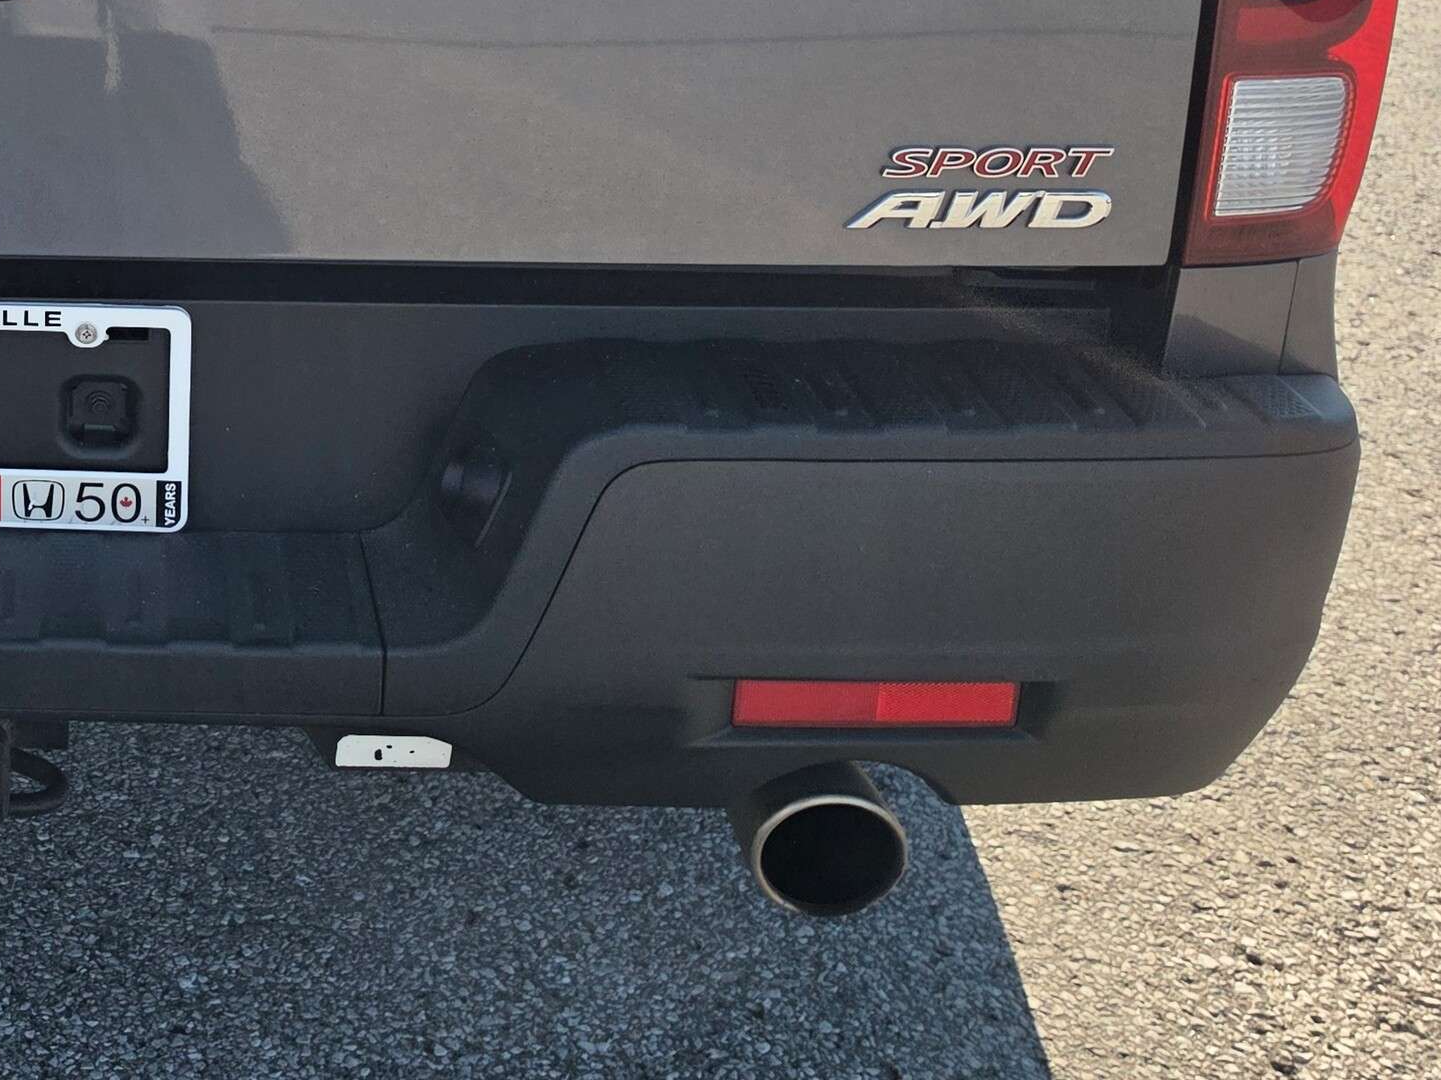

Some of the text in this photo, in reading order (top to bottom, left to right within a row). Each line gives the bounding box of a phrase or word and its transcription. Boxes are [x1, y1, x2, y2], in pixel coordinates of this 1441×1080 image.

[882, 147, 1115, 178] SPORT
[846, 191, 1112, 229] AWD
[75, 482, 142, 523] 50
[164, 483, 176, 526] YEARS
